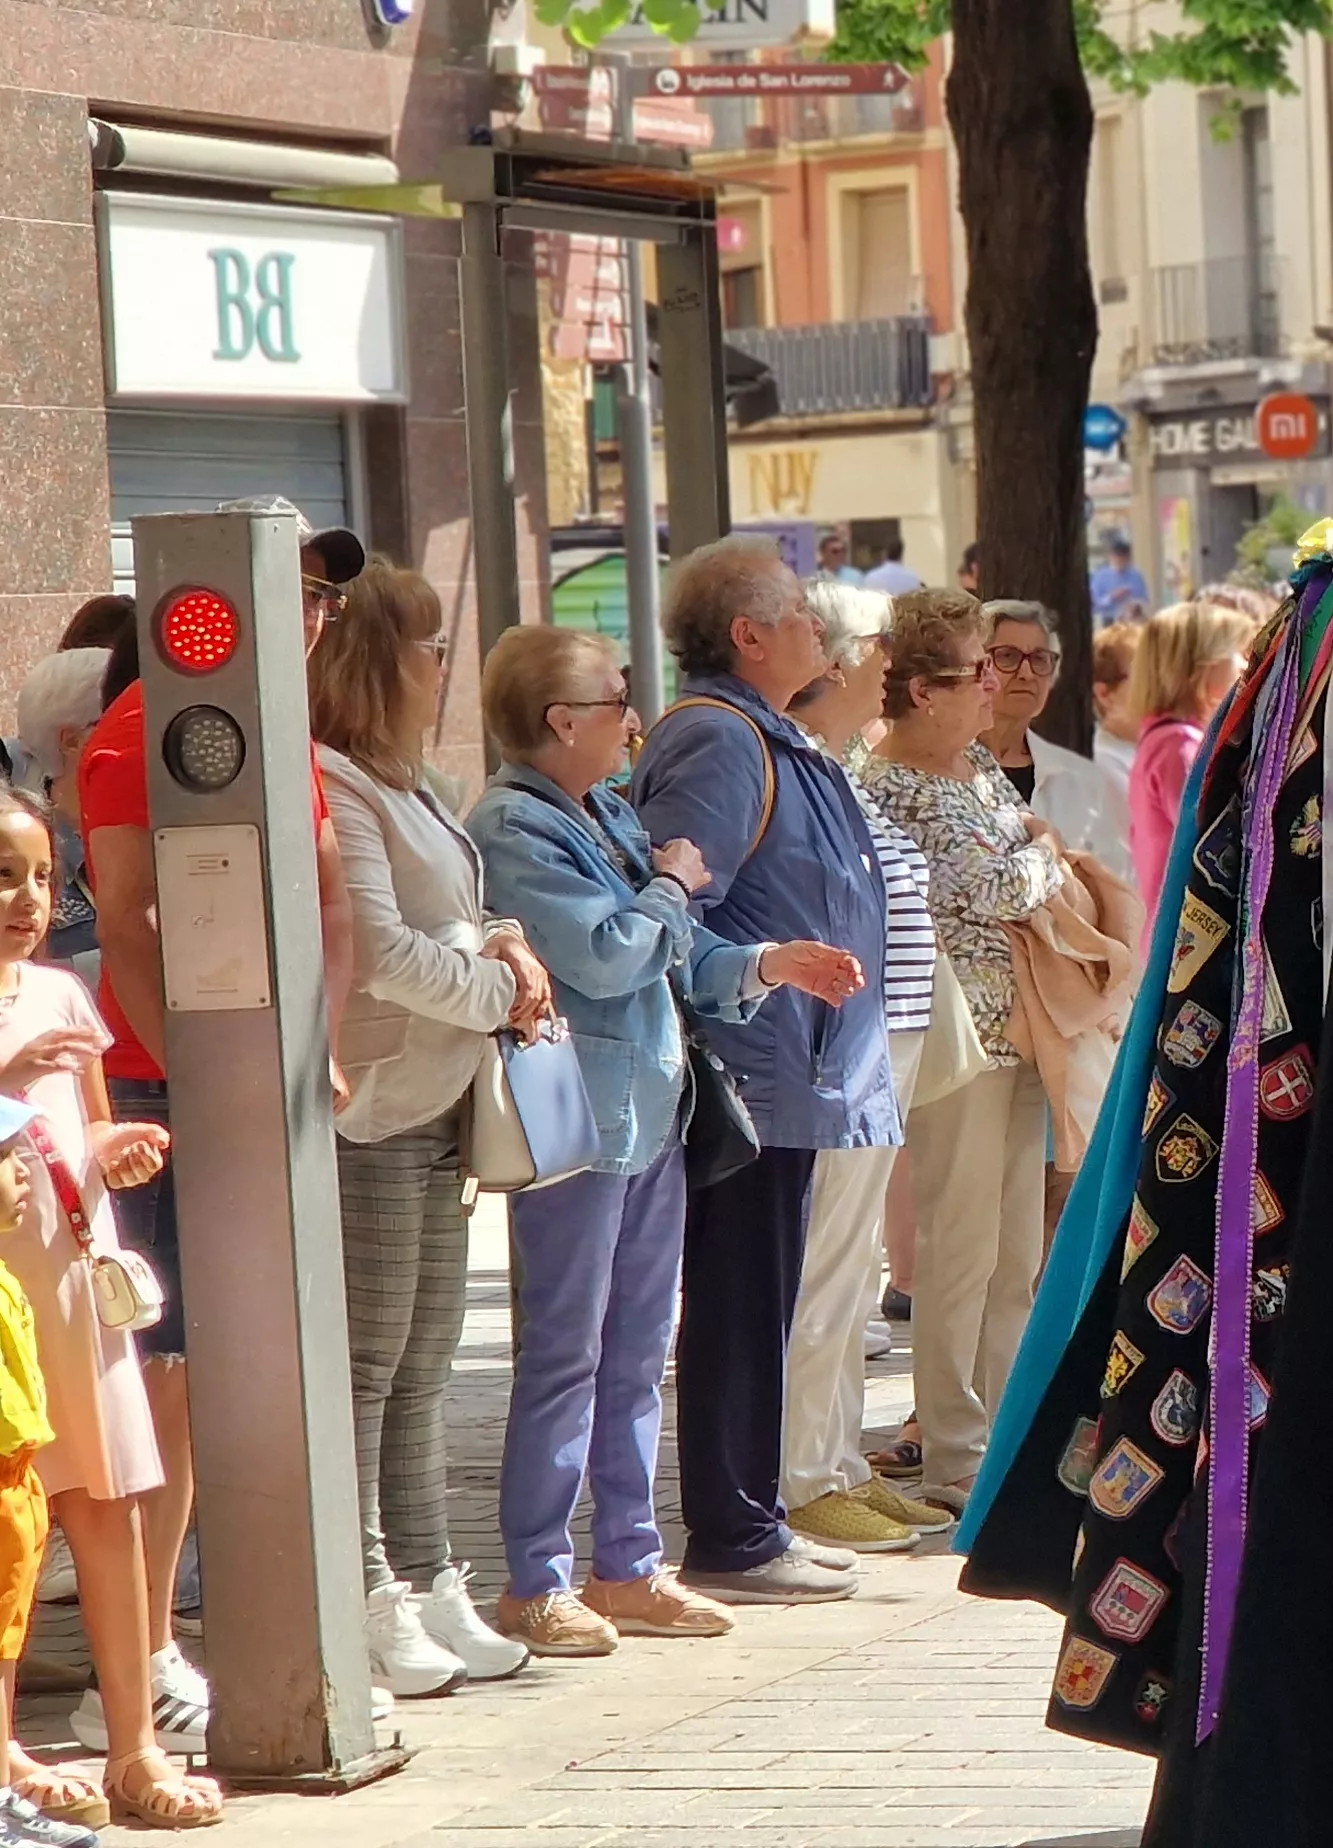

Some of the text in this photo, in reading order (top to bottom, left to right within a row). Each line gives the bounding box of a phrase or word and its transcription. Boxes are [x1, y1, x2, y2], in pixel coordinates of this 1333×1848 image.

[687, 74, 851, 91] Iglesia de San Lorenzo
[1150, 421, 1210, 455] HOME
[1187, 907, 1222, 936] JERSEY
